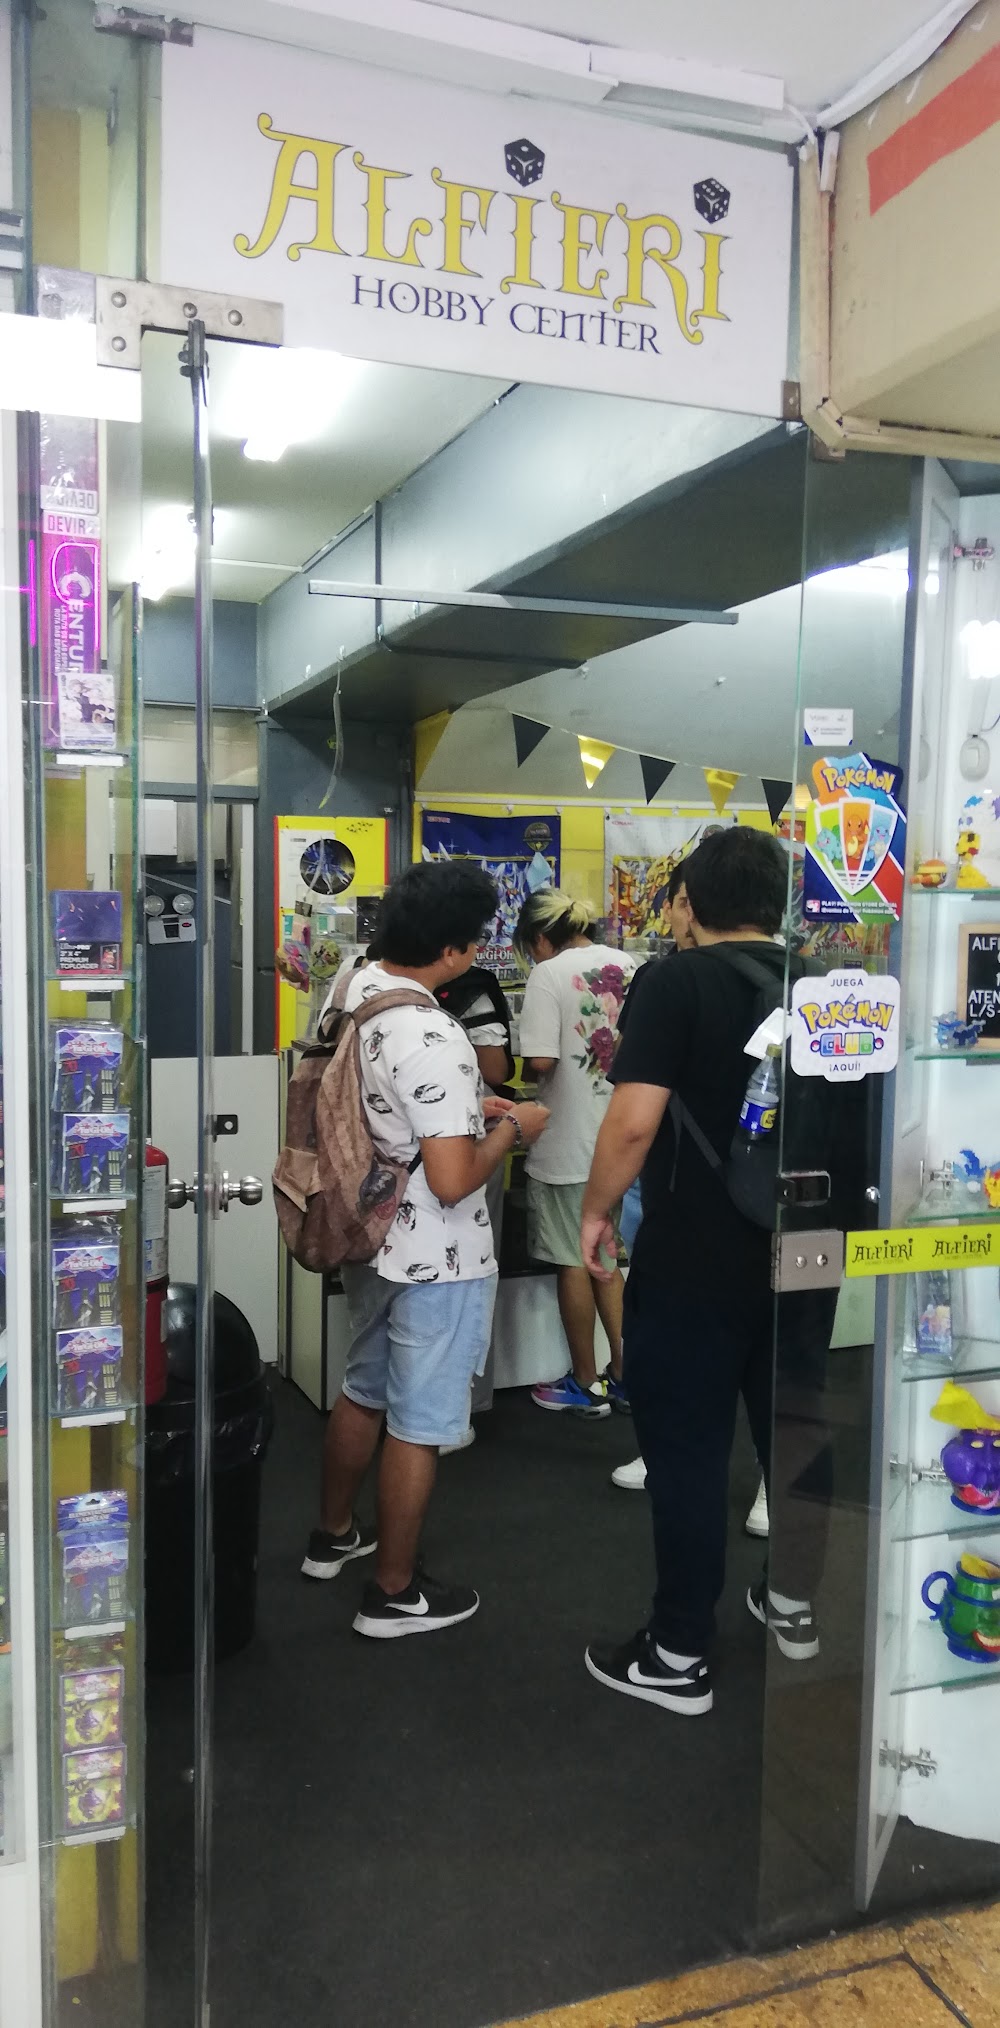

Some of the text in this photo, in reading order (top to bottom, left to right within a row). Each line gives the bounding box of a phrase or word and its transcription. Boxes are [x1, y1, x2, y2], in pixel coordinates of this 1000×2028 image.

[234, 112, 731, 344] ALFIERI
[351, 274, 661, 355] HOBBY CENTER
[47, 515, 86, 535] DEVIR
[830, 978, 864, 987] JUEGA
[821, 1033, 874, 1056] CLUB
[829, 1061, 861, 1072] ¡AQUÍ!
[852, 1233, 992, 1263] ALFIERI ALFIERI
